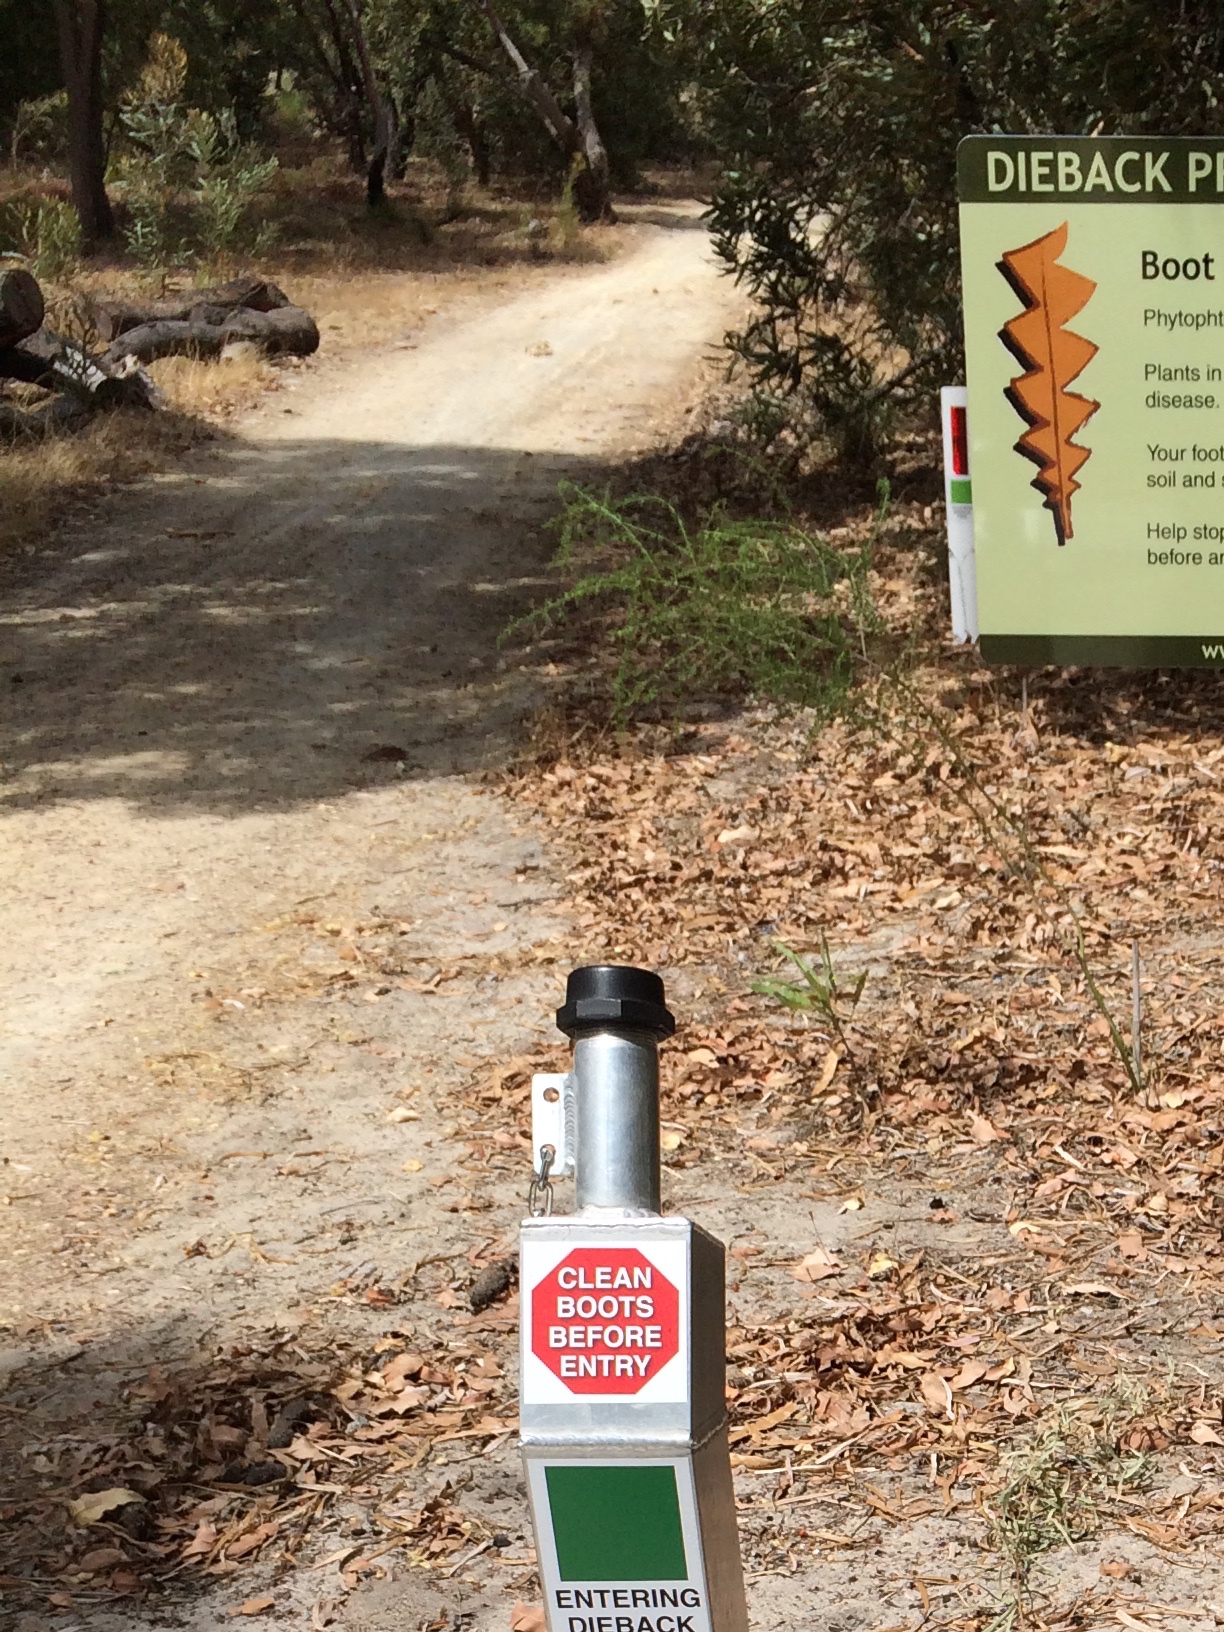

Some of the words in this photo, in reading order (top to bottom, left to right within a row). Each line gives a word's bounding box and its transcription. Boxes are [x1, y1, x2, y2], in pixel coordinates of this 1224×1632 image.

[988, 151, 1172, 193] DIEBACK
[1142, 251, 1214, 280] Boot
[1144, 364, 1201, 382] Plants
[1207, 364, 1222, 382] in
[1145, 390, 1219, 409] disease.
[1147, 444, 1186, 462] Your
[1147, 470, 1177, 488] soil
[1183, 470, 1215, 488] and
[1147, 522, 1188, 544] Help
[1147, 548, 1202, 566] before
[557, 1267, 652, 1289] CLEAN
[557, 1296, 654, 1318] BOOTS
[549, 1325, 662, 1348] BEFORE
[560, 1354, 652, 1378] ENTRY
[556, 1589, 701, 1609] ENTERING
